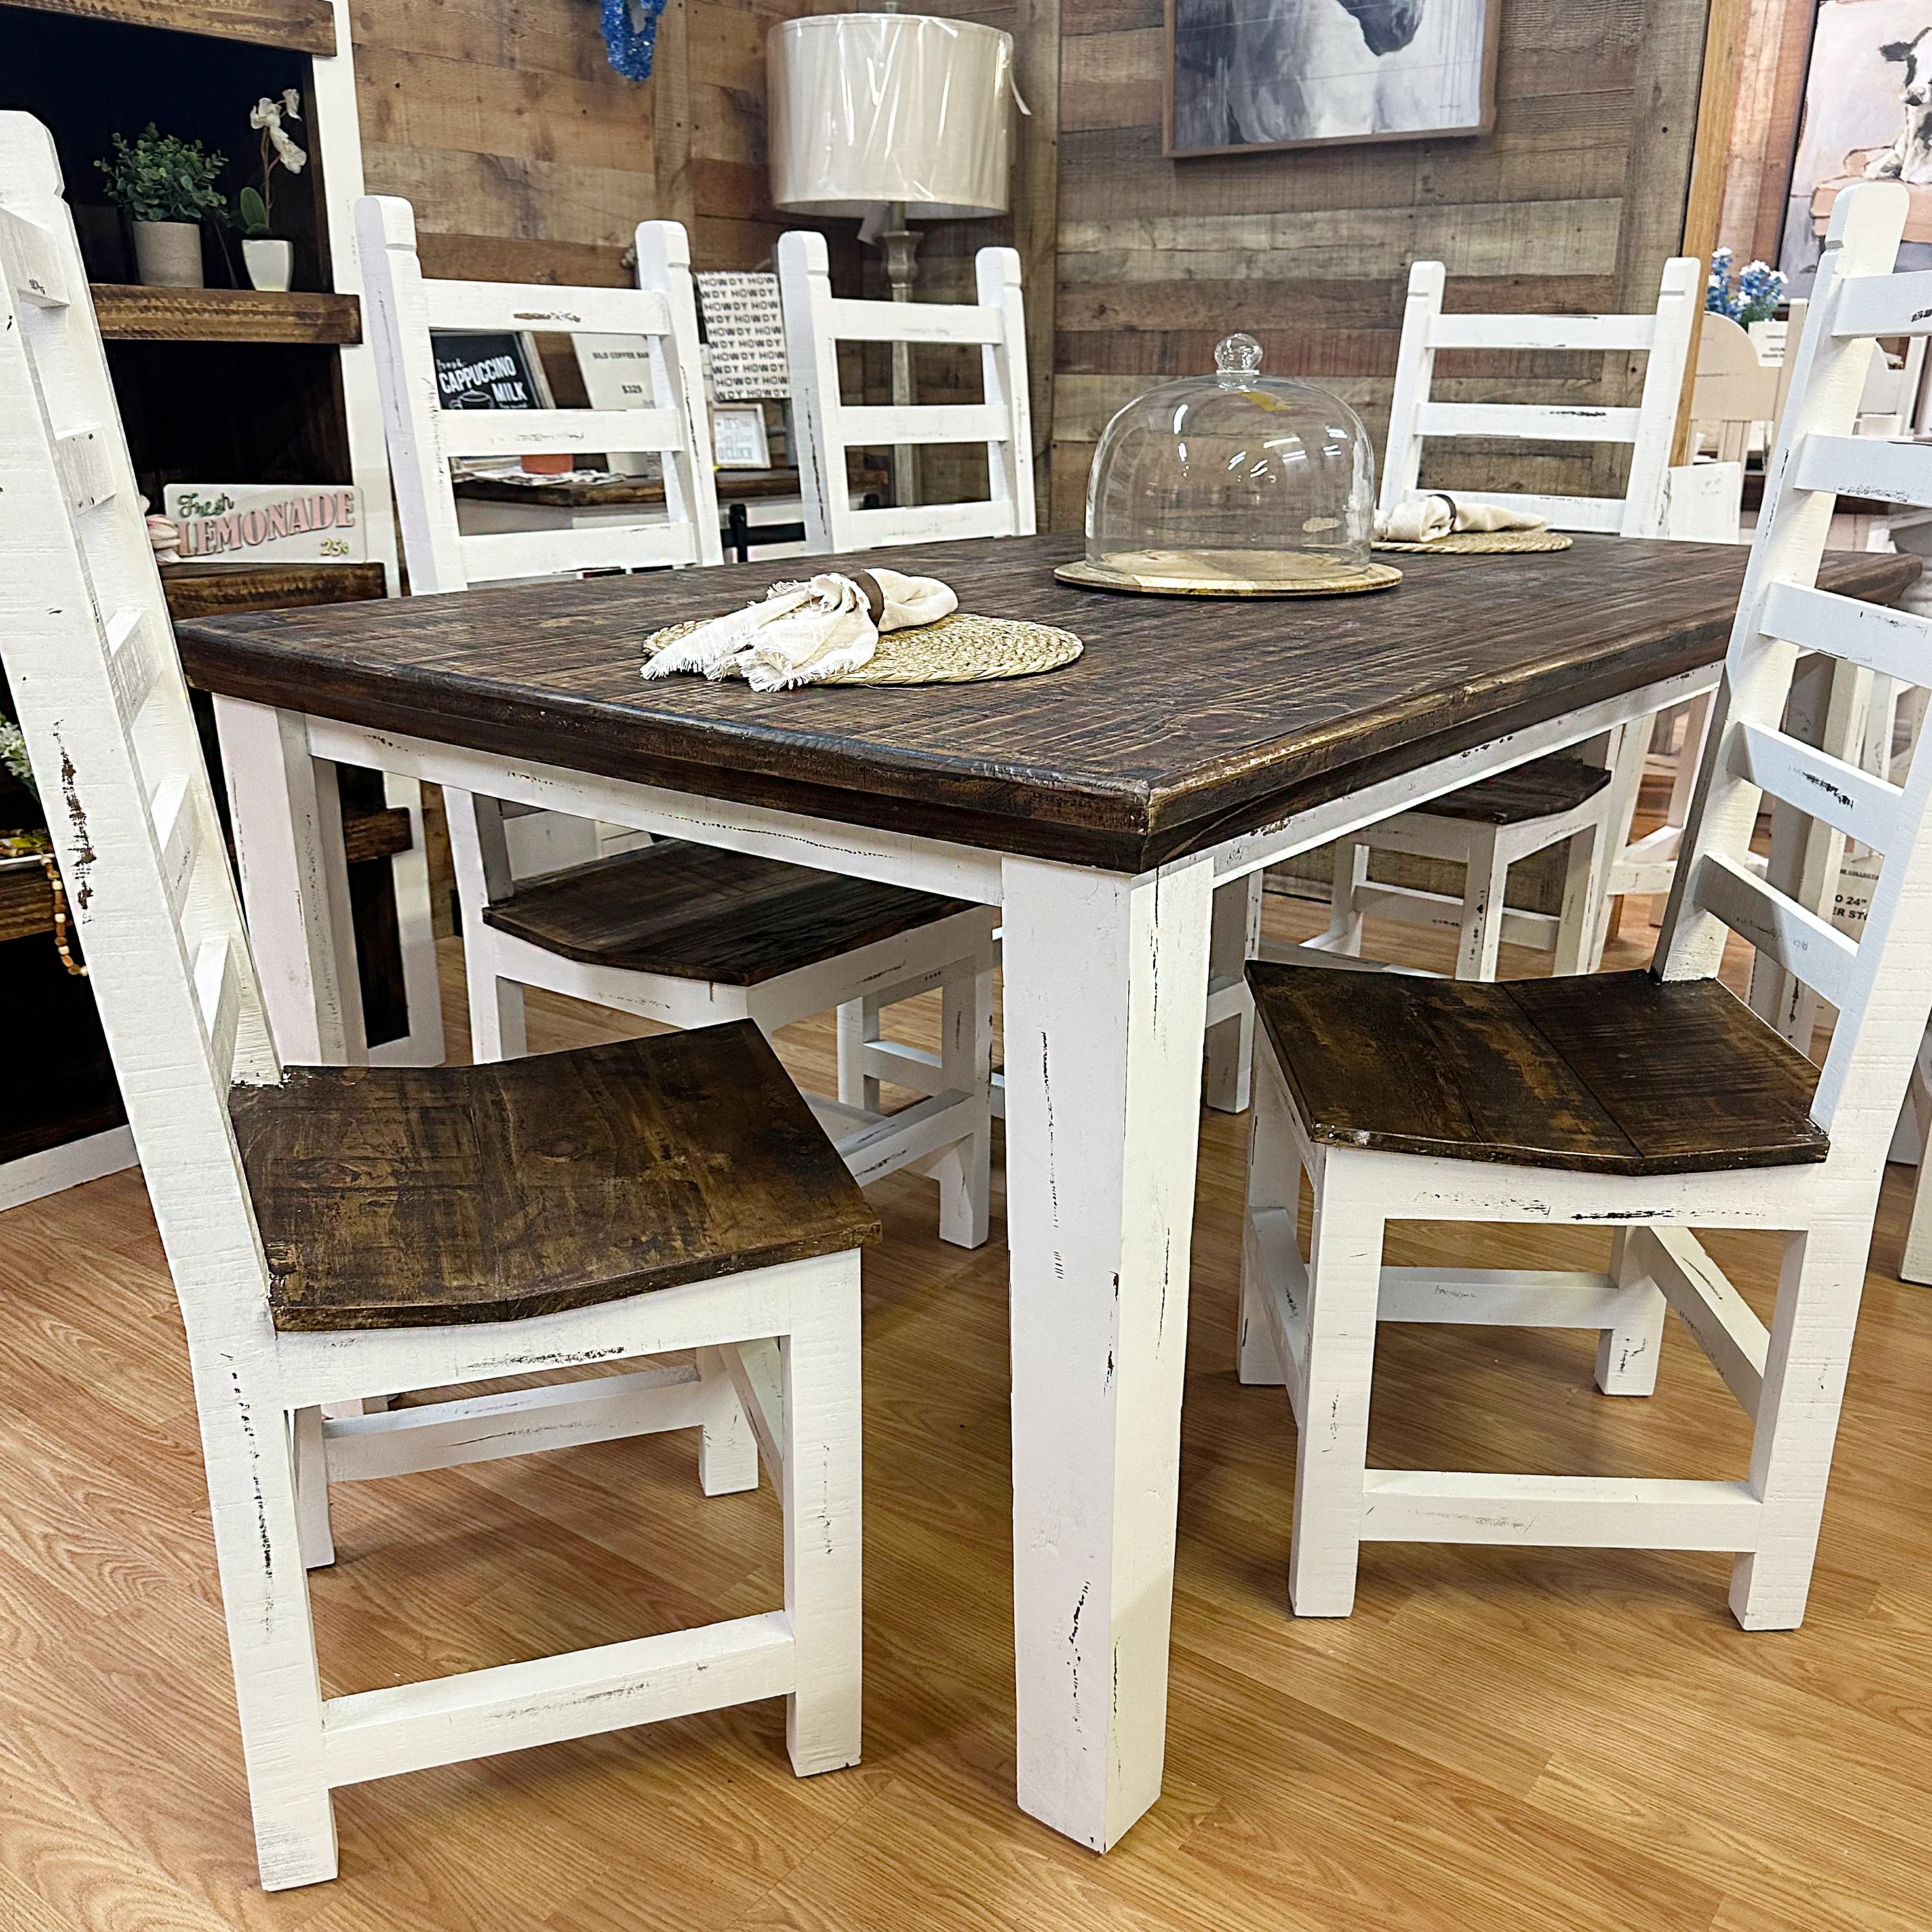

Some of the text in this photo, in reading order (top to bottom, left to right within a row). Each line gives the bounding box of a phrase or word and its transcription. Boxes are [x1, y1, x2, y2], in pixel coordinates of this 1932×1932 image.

[700, 277, 743, 286] HOWDY
[731, 288, 774, 298] HOWDY
[704, 302, 748, 311] HOWDY
[734, 314, 777, 323] HOWDY
[708, 327, 751, 336] HOWDY
[738, 339, 781, 348] HOWDY
[712, 352, 755, 361] HOWDY
[743, 363, 785, 372] HOWDY
[439, 355, 517, 394] CAPPUCCINO
[716, 377, 759, 387] HOWDY
[491, 382, 528, 402] MILK
[746, 388, 787, 397] HOWDY
[178, 493, 235, 518] Fresh
[176, 490, 355, 557] LEMONADE
